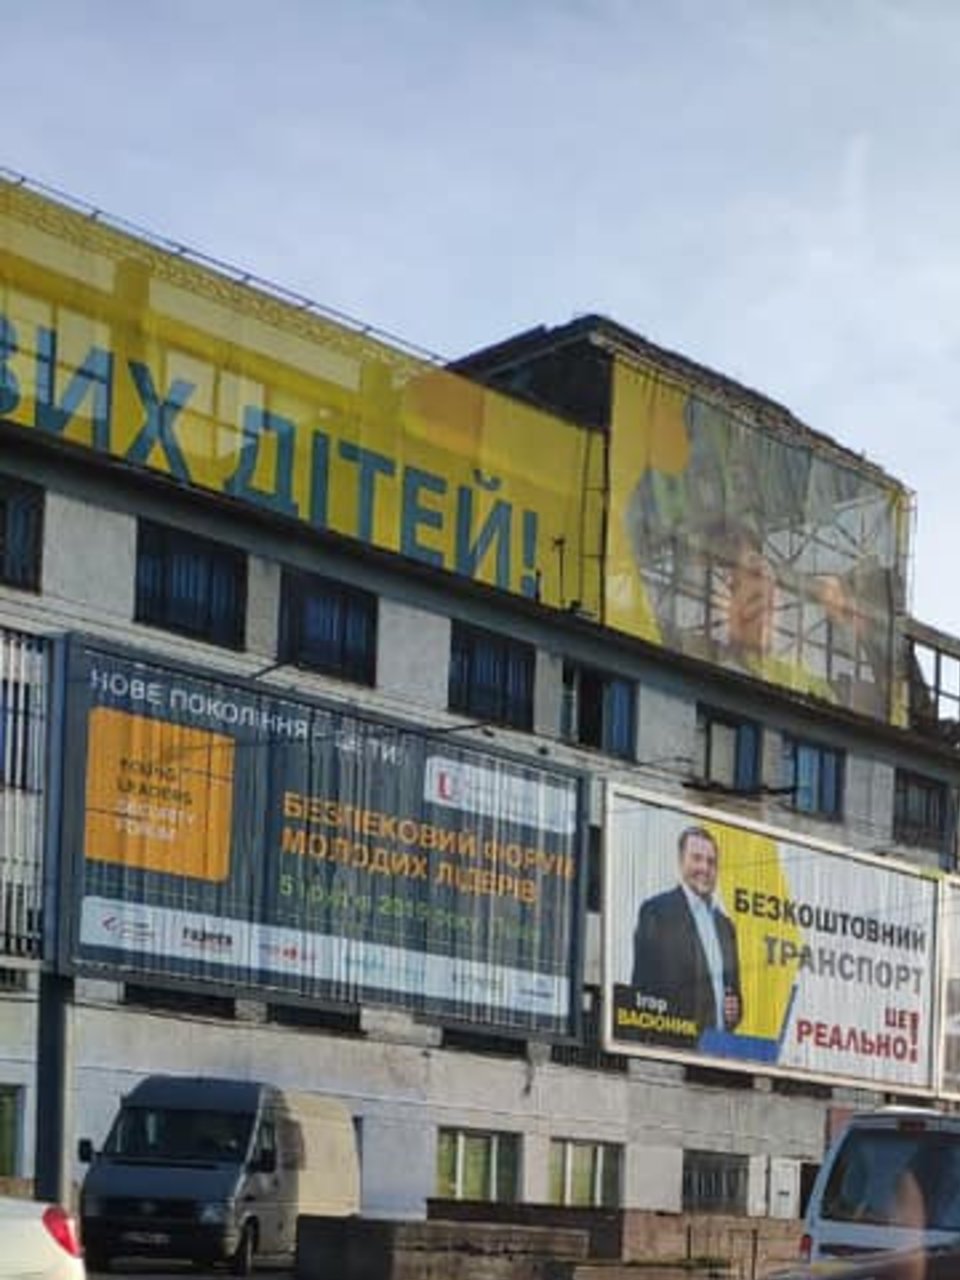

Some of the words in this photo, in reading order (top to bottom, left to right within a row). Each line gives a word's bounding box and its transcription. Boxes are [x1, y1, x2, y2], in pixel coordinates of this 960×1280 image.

[222, 404, 538, 598] ДІТЕЙ!
[90, 668, 162, 704] НОВЕ
[169, 688, 308, 738] ПОКОЛІННЯ
[283, 791, 476, 858] БЕЗПЕКОВИЙ
[281, 827, 428, 880] МОЛОДИХ
[436, 861, 538, 904] ЛІДЕРІВ
[764, 935, 924, 995] ТРАНСПОРТ
[636, 991, 669, 1015] Ігор
[884, 1007, 909, 1029] ЦЕ
[796, 1011, 920, 1064] РЕАЛЬНО!
